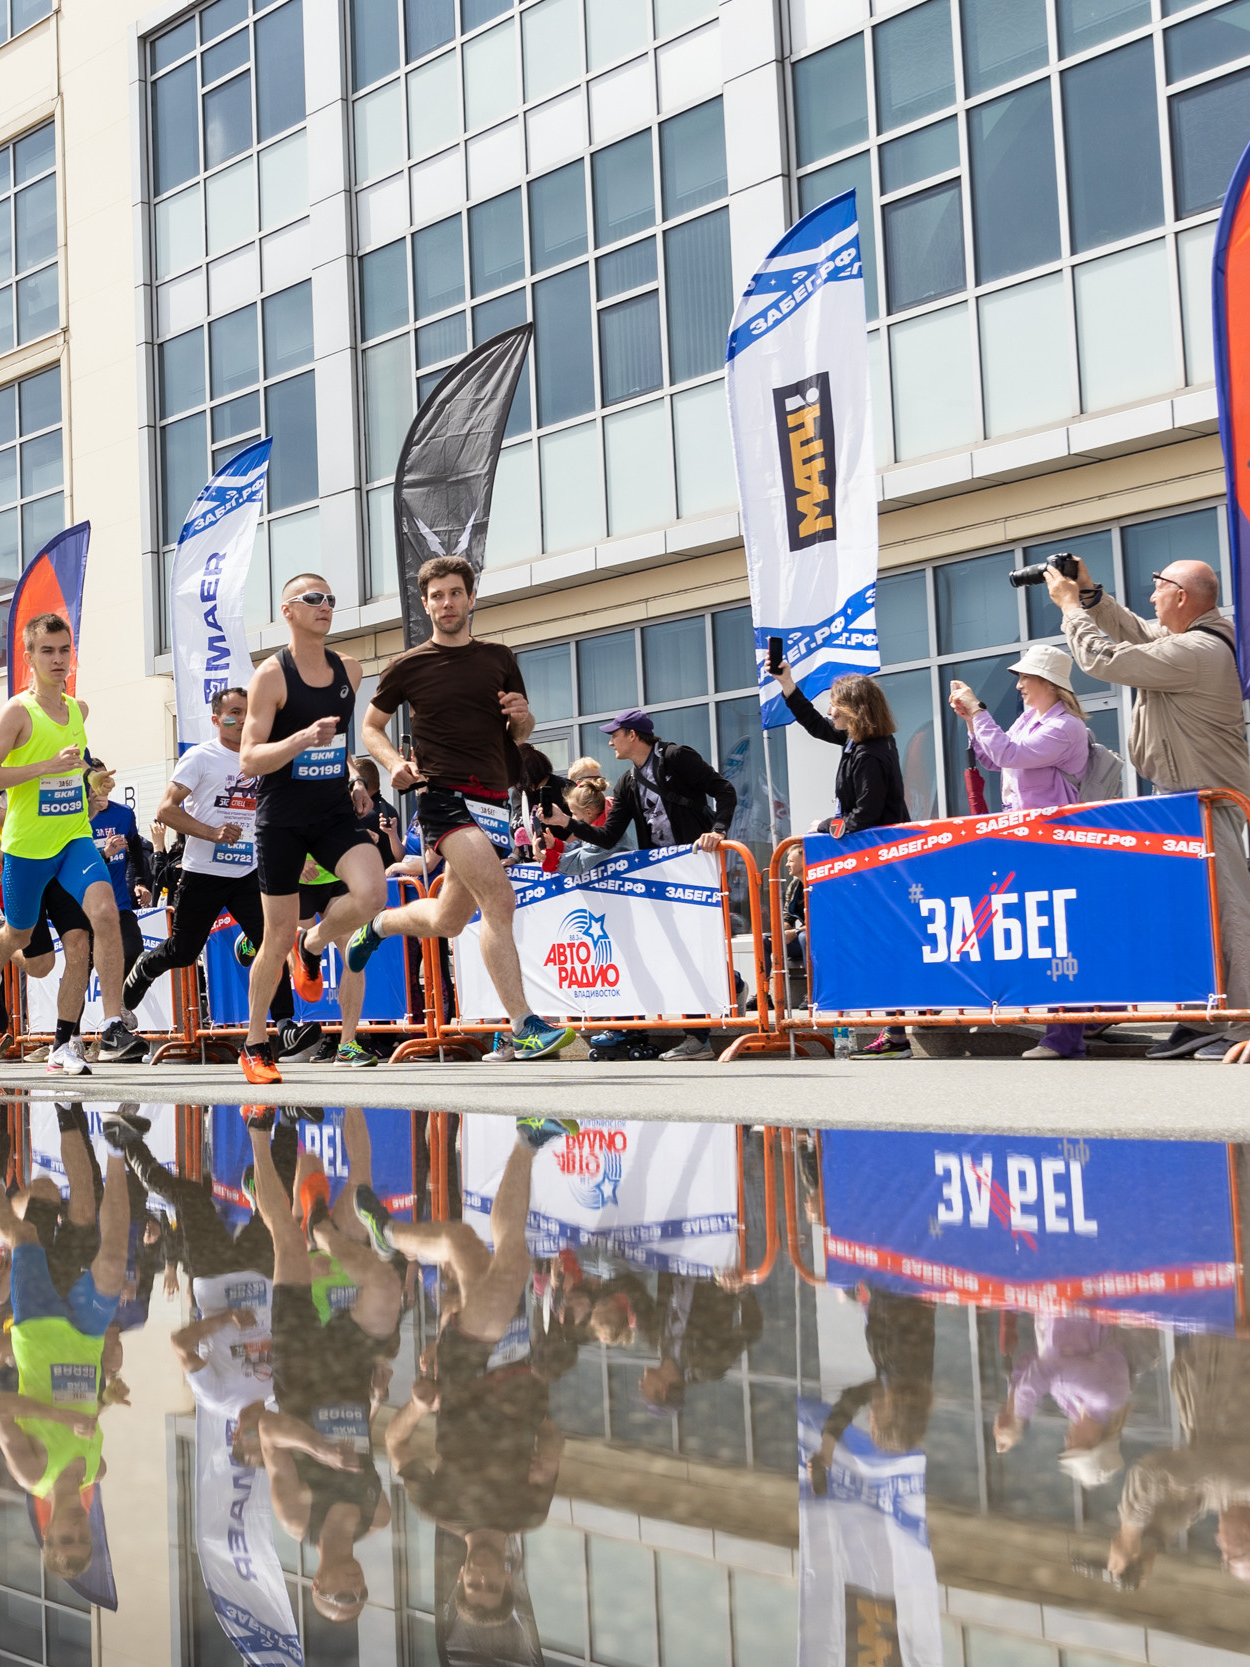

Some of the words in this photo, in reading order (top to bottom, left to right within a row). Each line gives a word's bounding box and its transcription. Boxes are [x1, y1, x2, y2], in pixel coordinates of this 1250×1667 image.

[749, 247, 857, 336] ЗАБЕГ.РФ
[199, 551, 231, 671] MAER
[298, 764, 342, 776] 50198
[41, 801, 82, 813] 50039
[878, 832, 953, 861] ЗАБЕГ.РФ
[1053, 829, 1137, 847] ЗАБЕГ.РФ
[216, 852, 252, 863] 50722
[563, 859, 629, 889] ЗАБЕГ.РФ
[543, 941, 591, 967] АВТО
[558, 963, 620, 989] РАДИО
[574, 988, 621, 998] ВЛАДИВОСТОК
